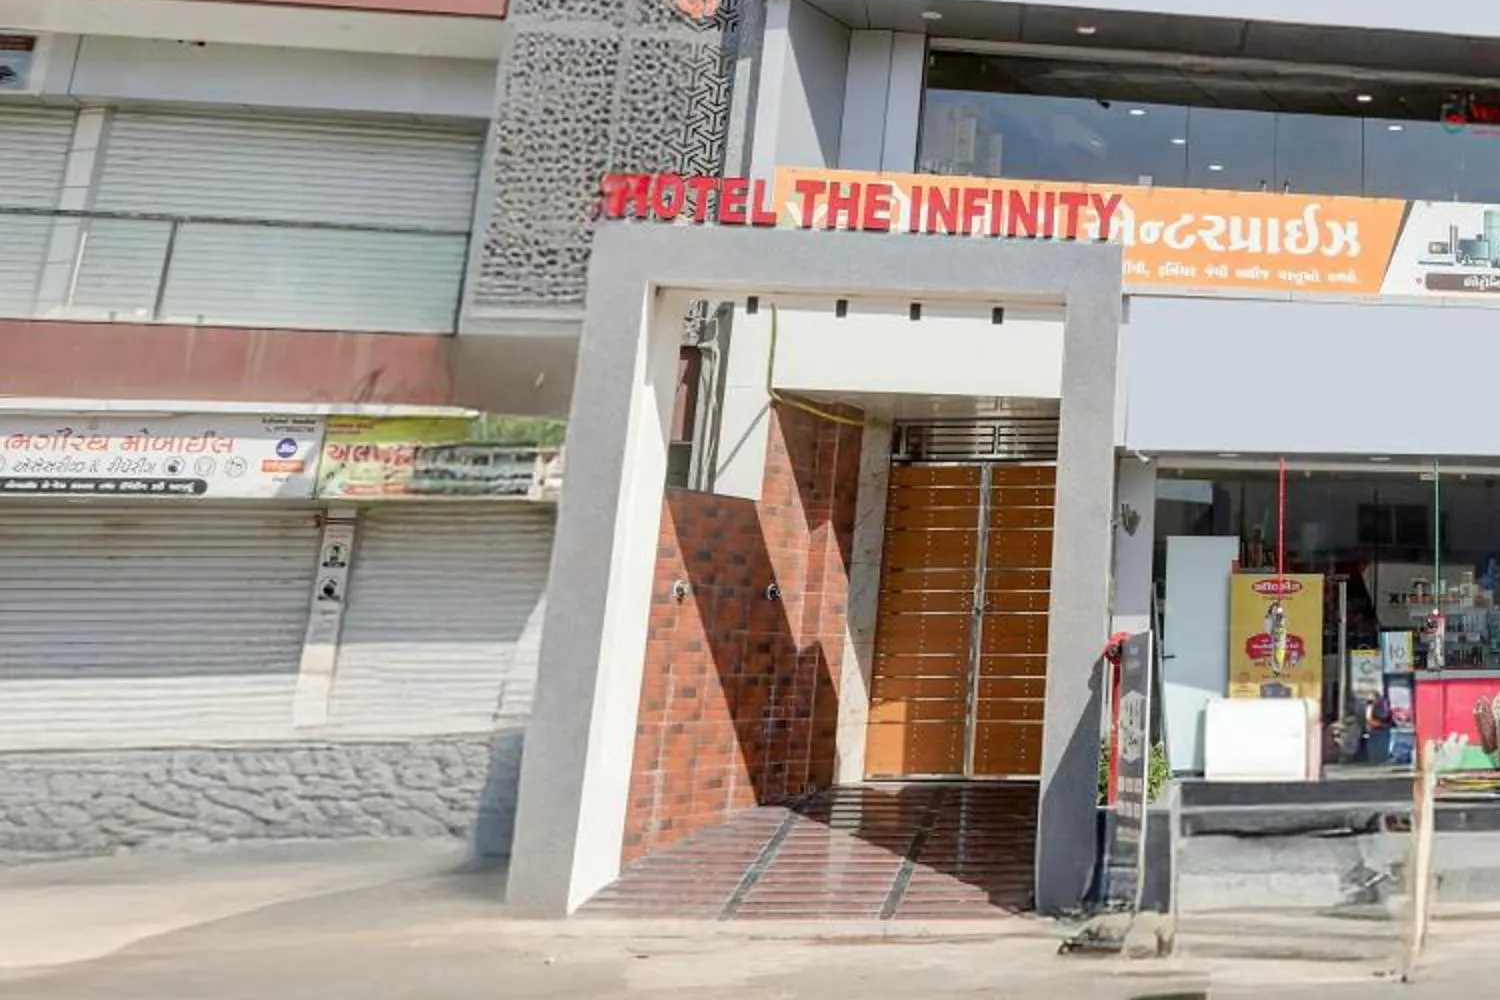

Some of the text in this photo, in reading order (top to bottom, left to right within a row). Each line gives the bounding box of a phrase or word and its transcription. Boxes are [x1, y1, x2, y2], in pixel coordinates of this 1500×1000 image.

[602, 172, 1123, 241] HOTEL THE INFINITY
